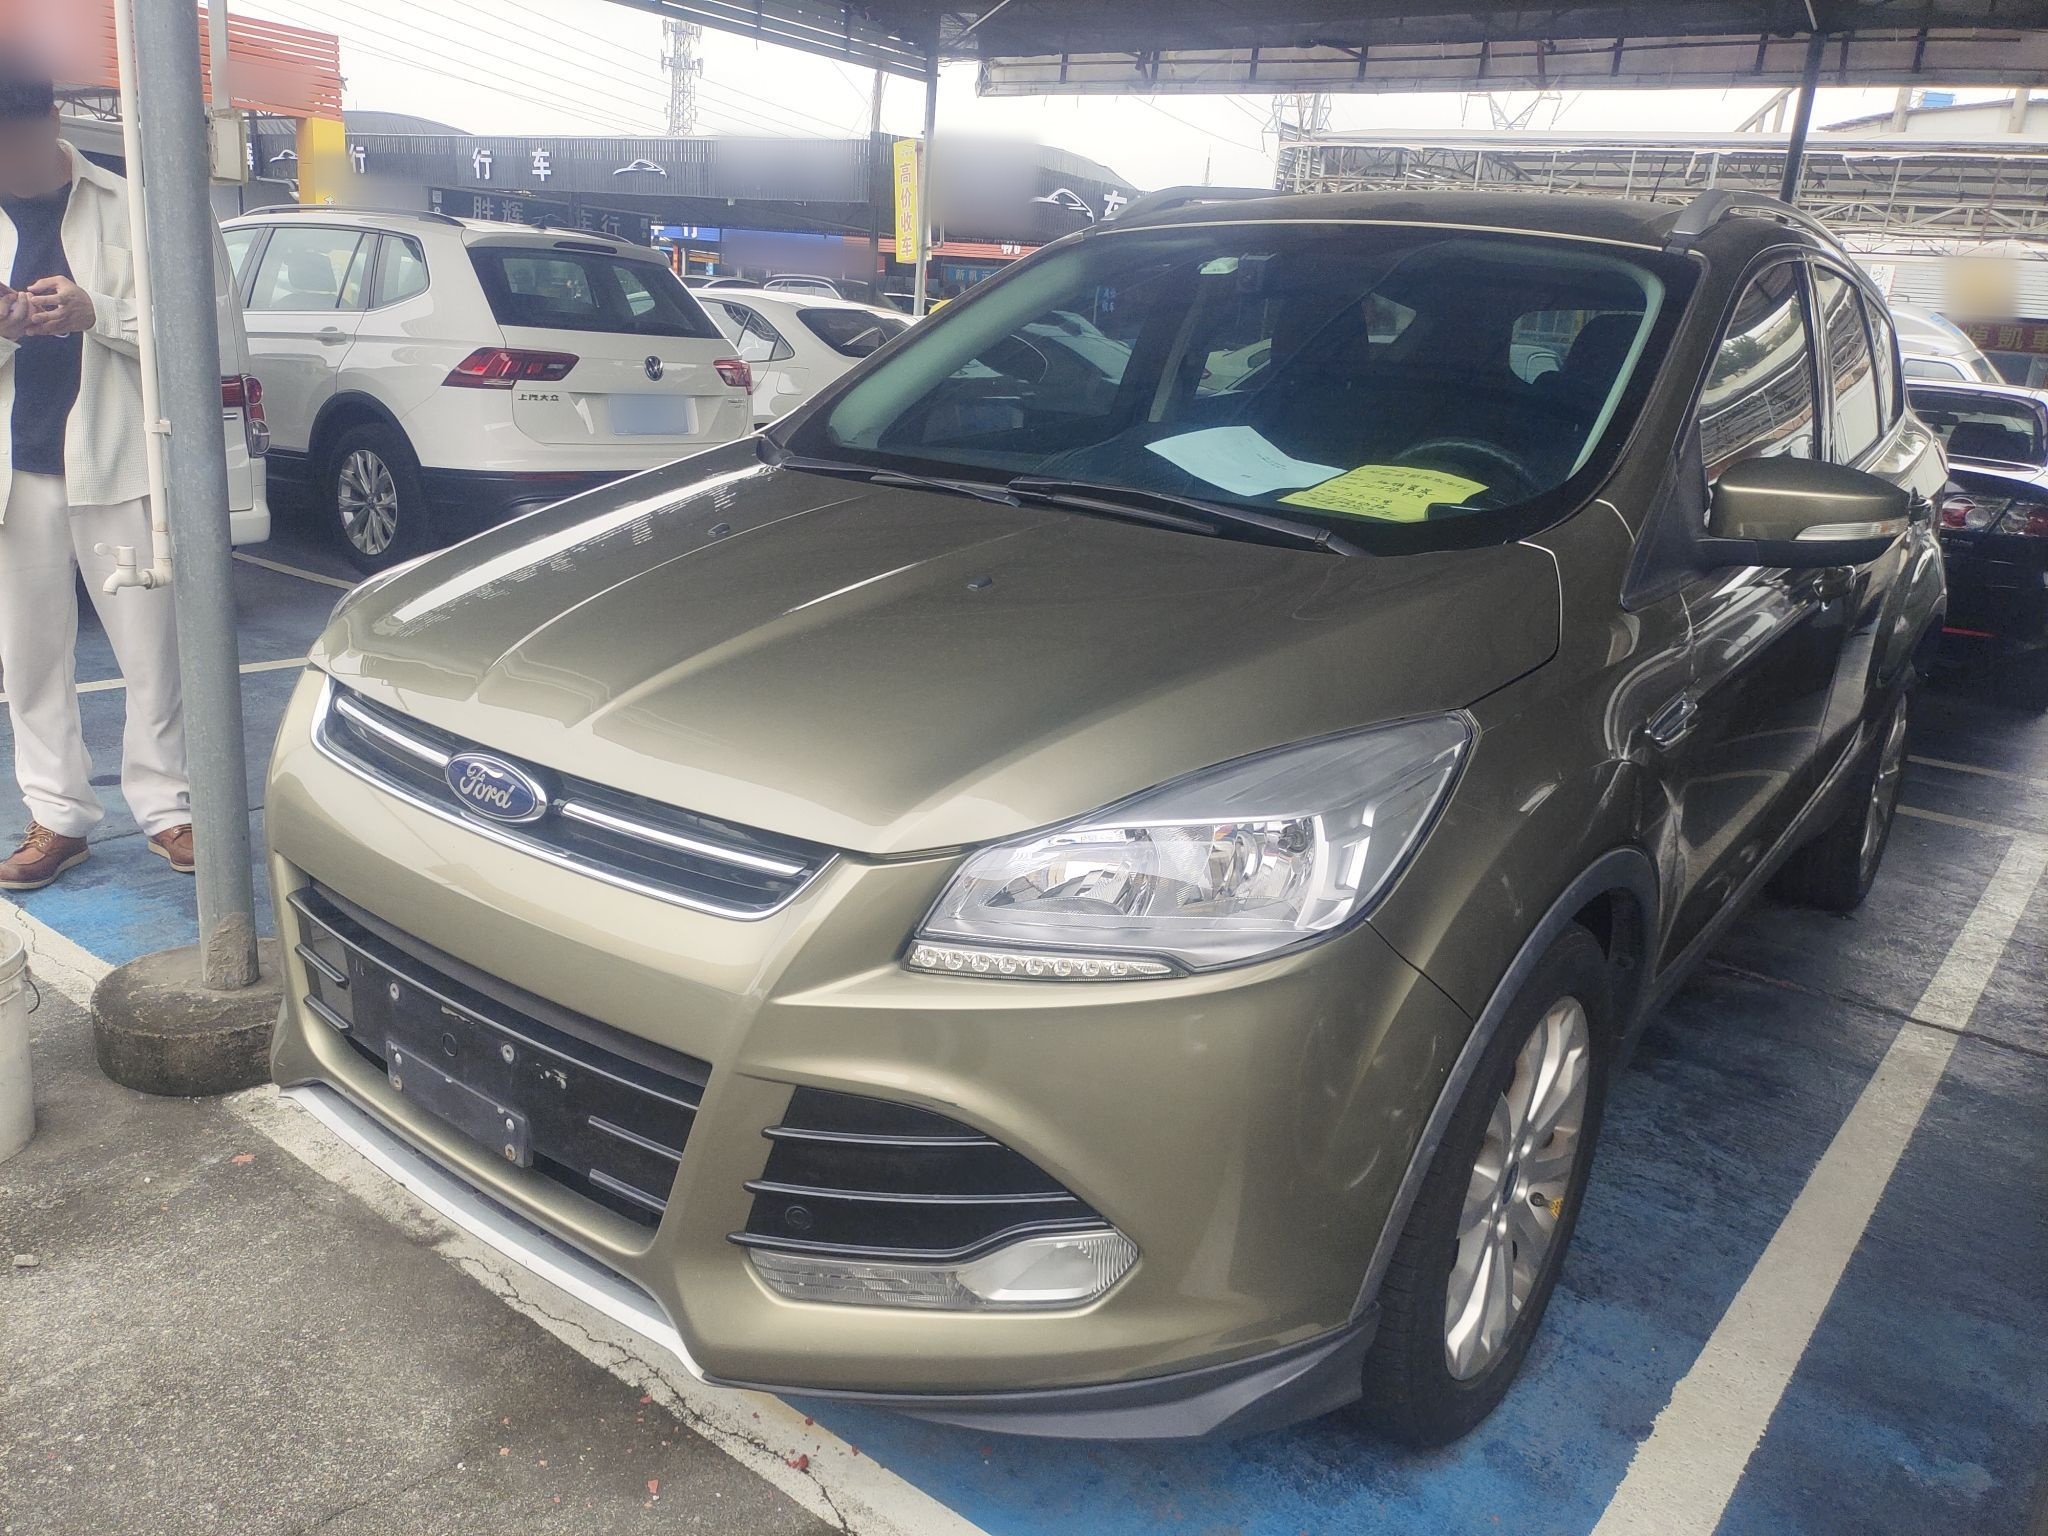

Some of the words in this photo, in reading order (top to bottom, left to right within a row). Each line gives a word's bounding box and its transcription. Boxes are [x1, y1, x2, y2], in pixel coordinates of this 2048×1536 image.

[900, 162, 913, 257] 高价收车
[517, 393, 560, 402] 上汽大众
[459, 762, 516, 809] Ford
